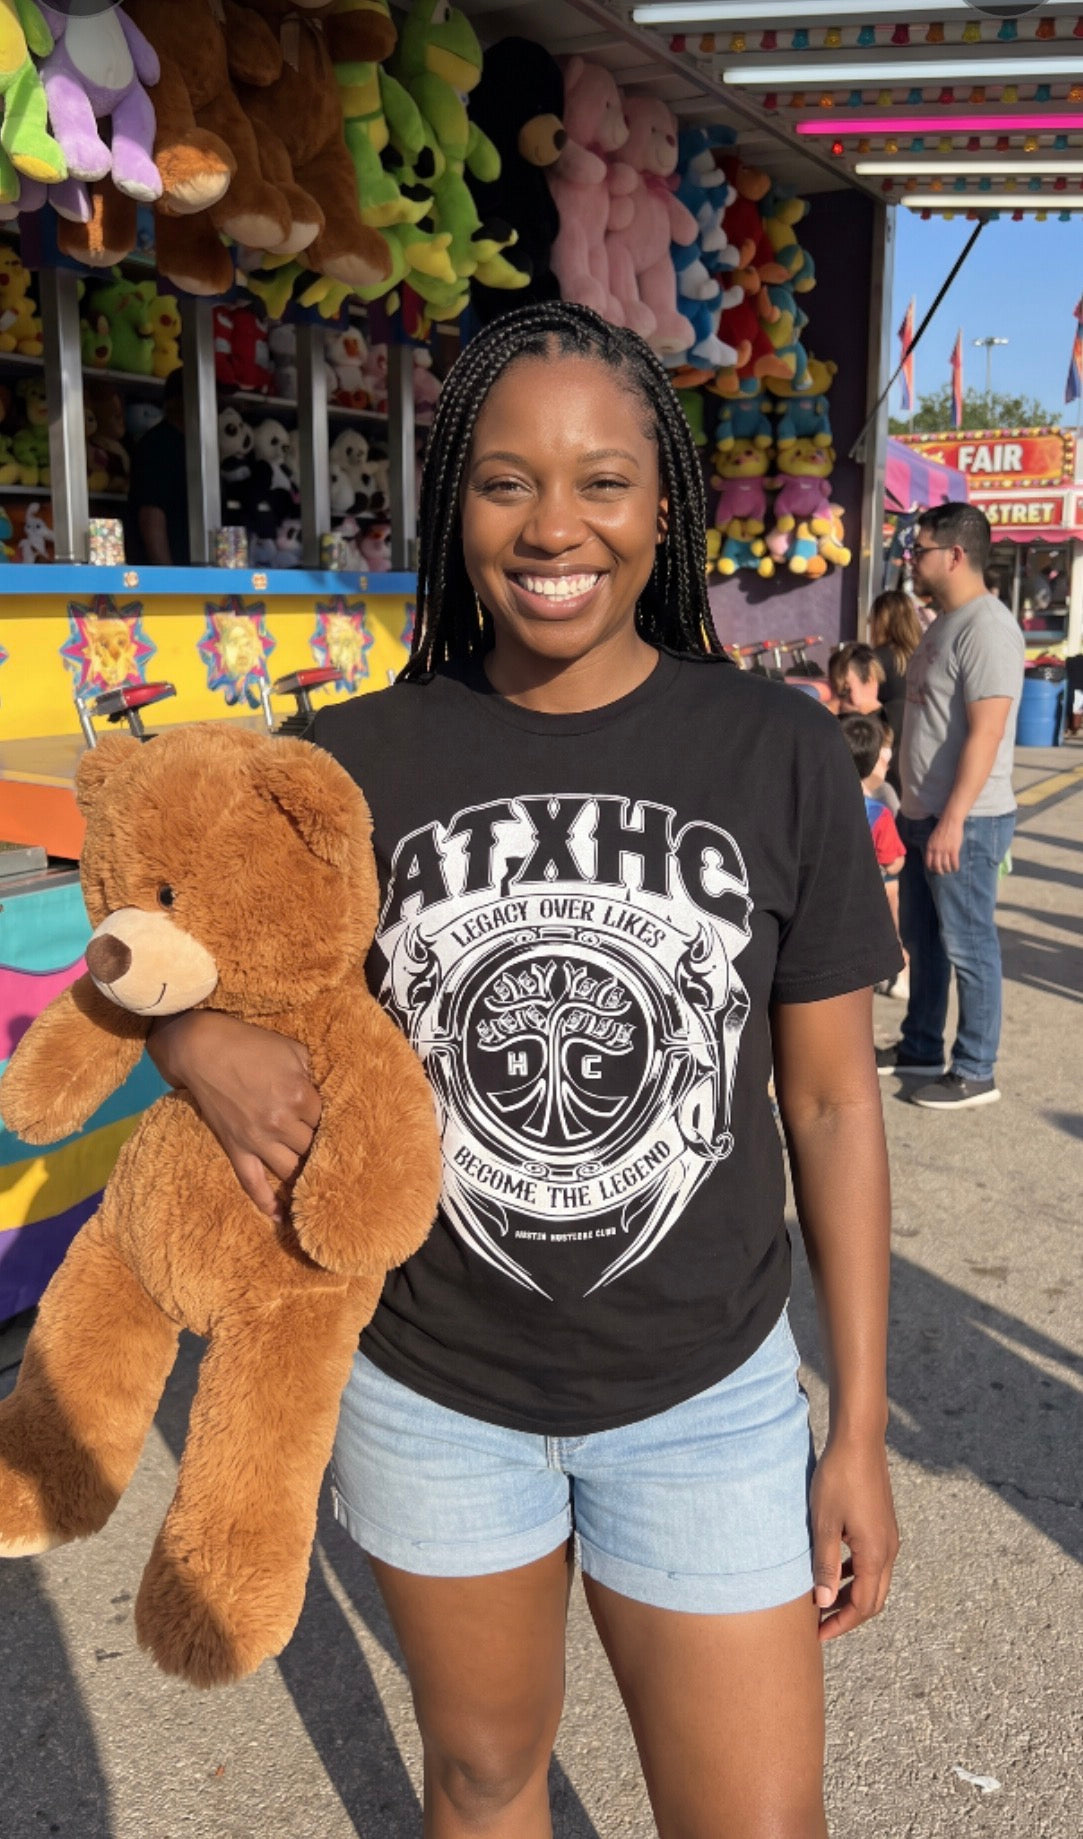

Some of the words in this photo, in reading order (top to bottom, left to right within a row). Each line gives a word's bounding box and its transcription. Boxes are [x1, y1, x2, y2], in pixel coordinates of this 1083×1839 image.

[958, 443, 1023, 473] FAIR
[978, 503, 1054, 524] STRET
[376, 793, 753, 937] ATXHC
[451, 900, 528, 947] LEGACY
[540, 898, 595, 922] OVER
[602, 905, 666, 948] LIKES
[507, 1051, 529, 1076] H
[581, 1054, 602, 1079] C
[454, 1146, 537, 1204] BECOME
[547, 1185, 591, 1208] THE
[600, 1140, 671, 1200] LEGEND
